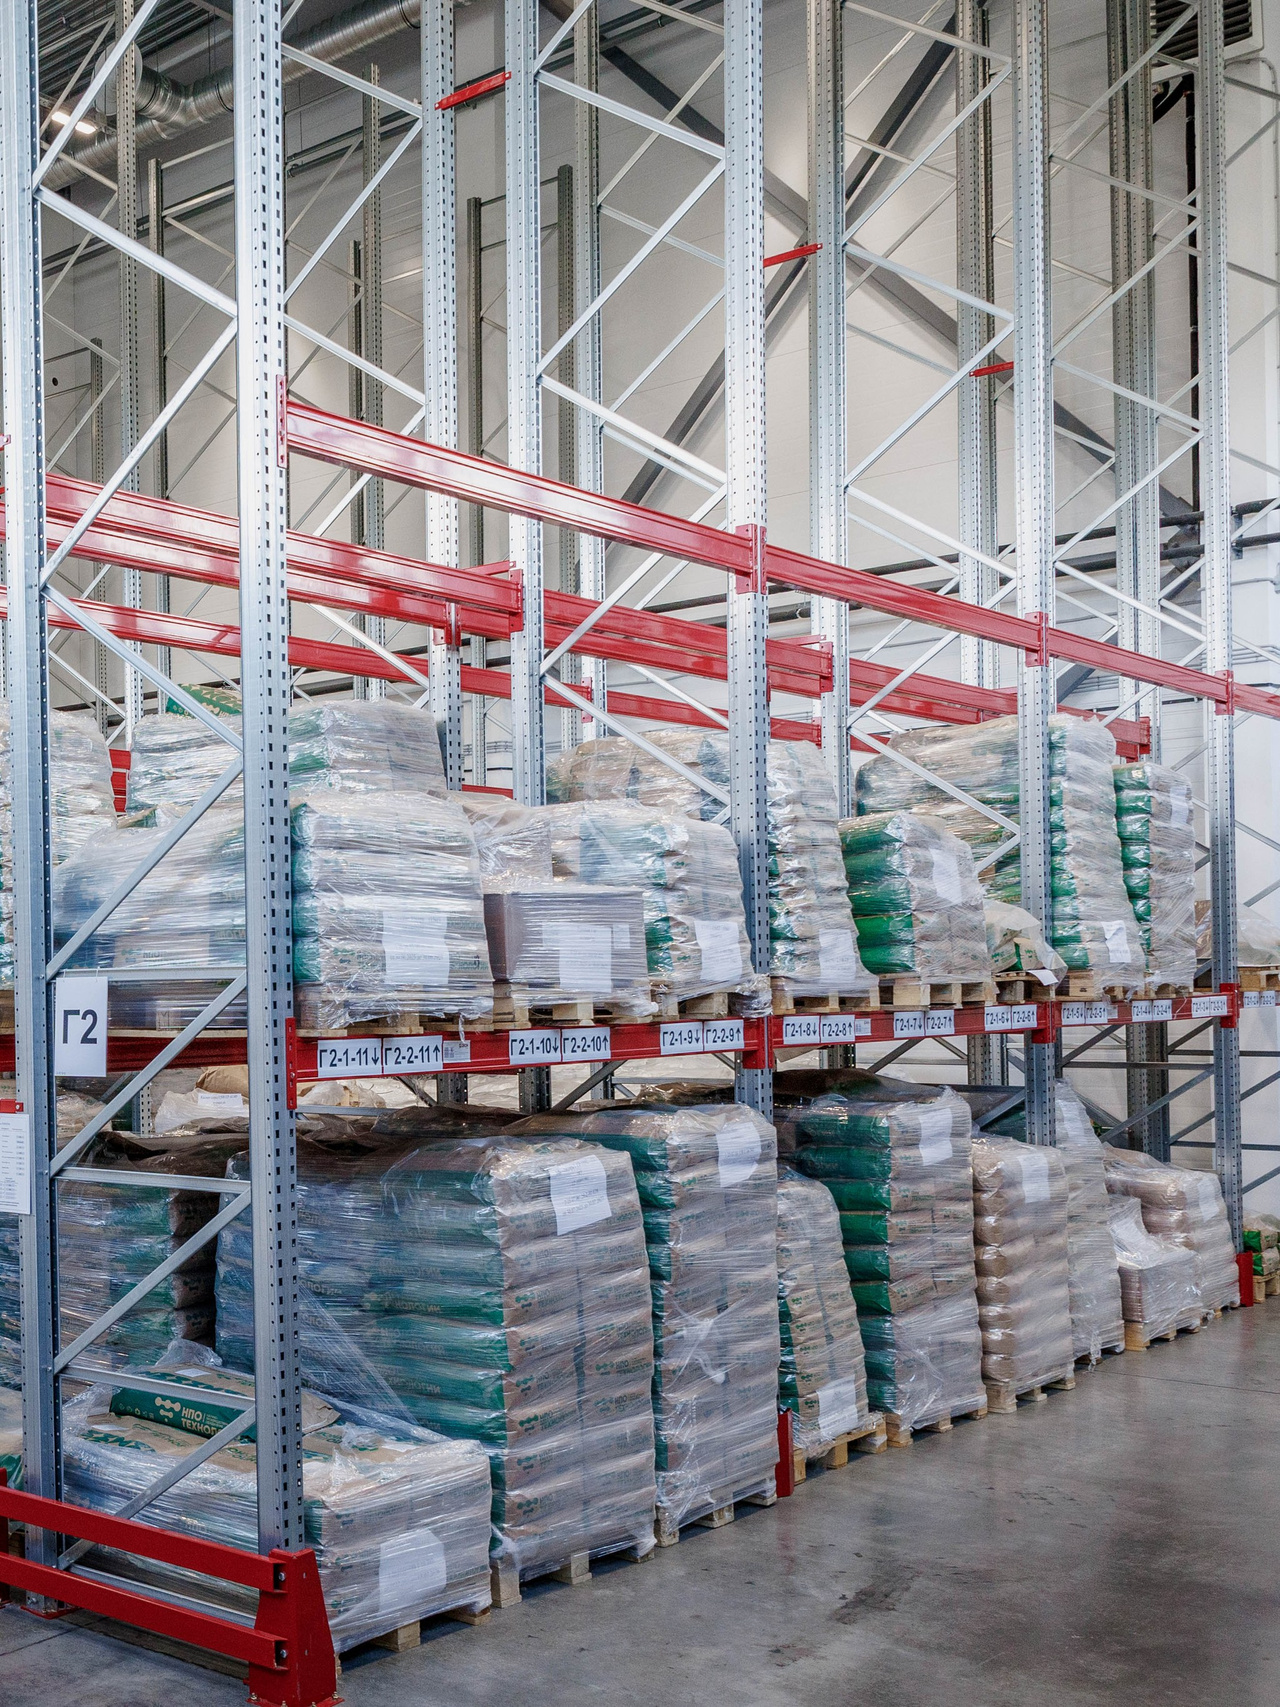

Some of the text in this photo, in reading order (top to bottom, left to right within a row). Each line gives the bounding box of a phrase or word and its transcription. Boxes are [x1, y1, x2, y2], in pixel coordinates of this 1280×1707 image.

[895, 1017, 918, 1032] Г2-1-7
[926, 1016, 948, 1030] Г2-2-7
[986, 1012, 1006, 1025] Г2-1-6
[1013, 1010, 1031, 1023] Г2-2-6
[62, 1008, 98, 1045] Г2
[784, 1022, 811, 1038] Г2-1-8
[822, 1022, 847, 1038] Г2-2-8
[662, 1029, 693, 1047] Г2-1-9
[705, 1027, 735, 1044] Г2-2-9
[510, 1037, 552, 1056] Г2-1-10
[563, 1035, 602, 1054] Г2-2-10
[319, 1047, 369, 1068] Г2-1-11
[384, 1045, 430, 1066] Г2-2-11
[182, 1407, 203, 1420] НПО
